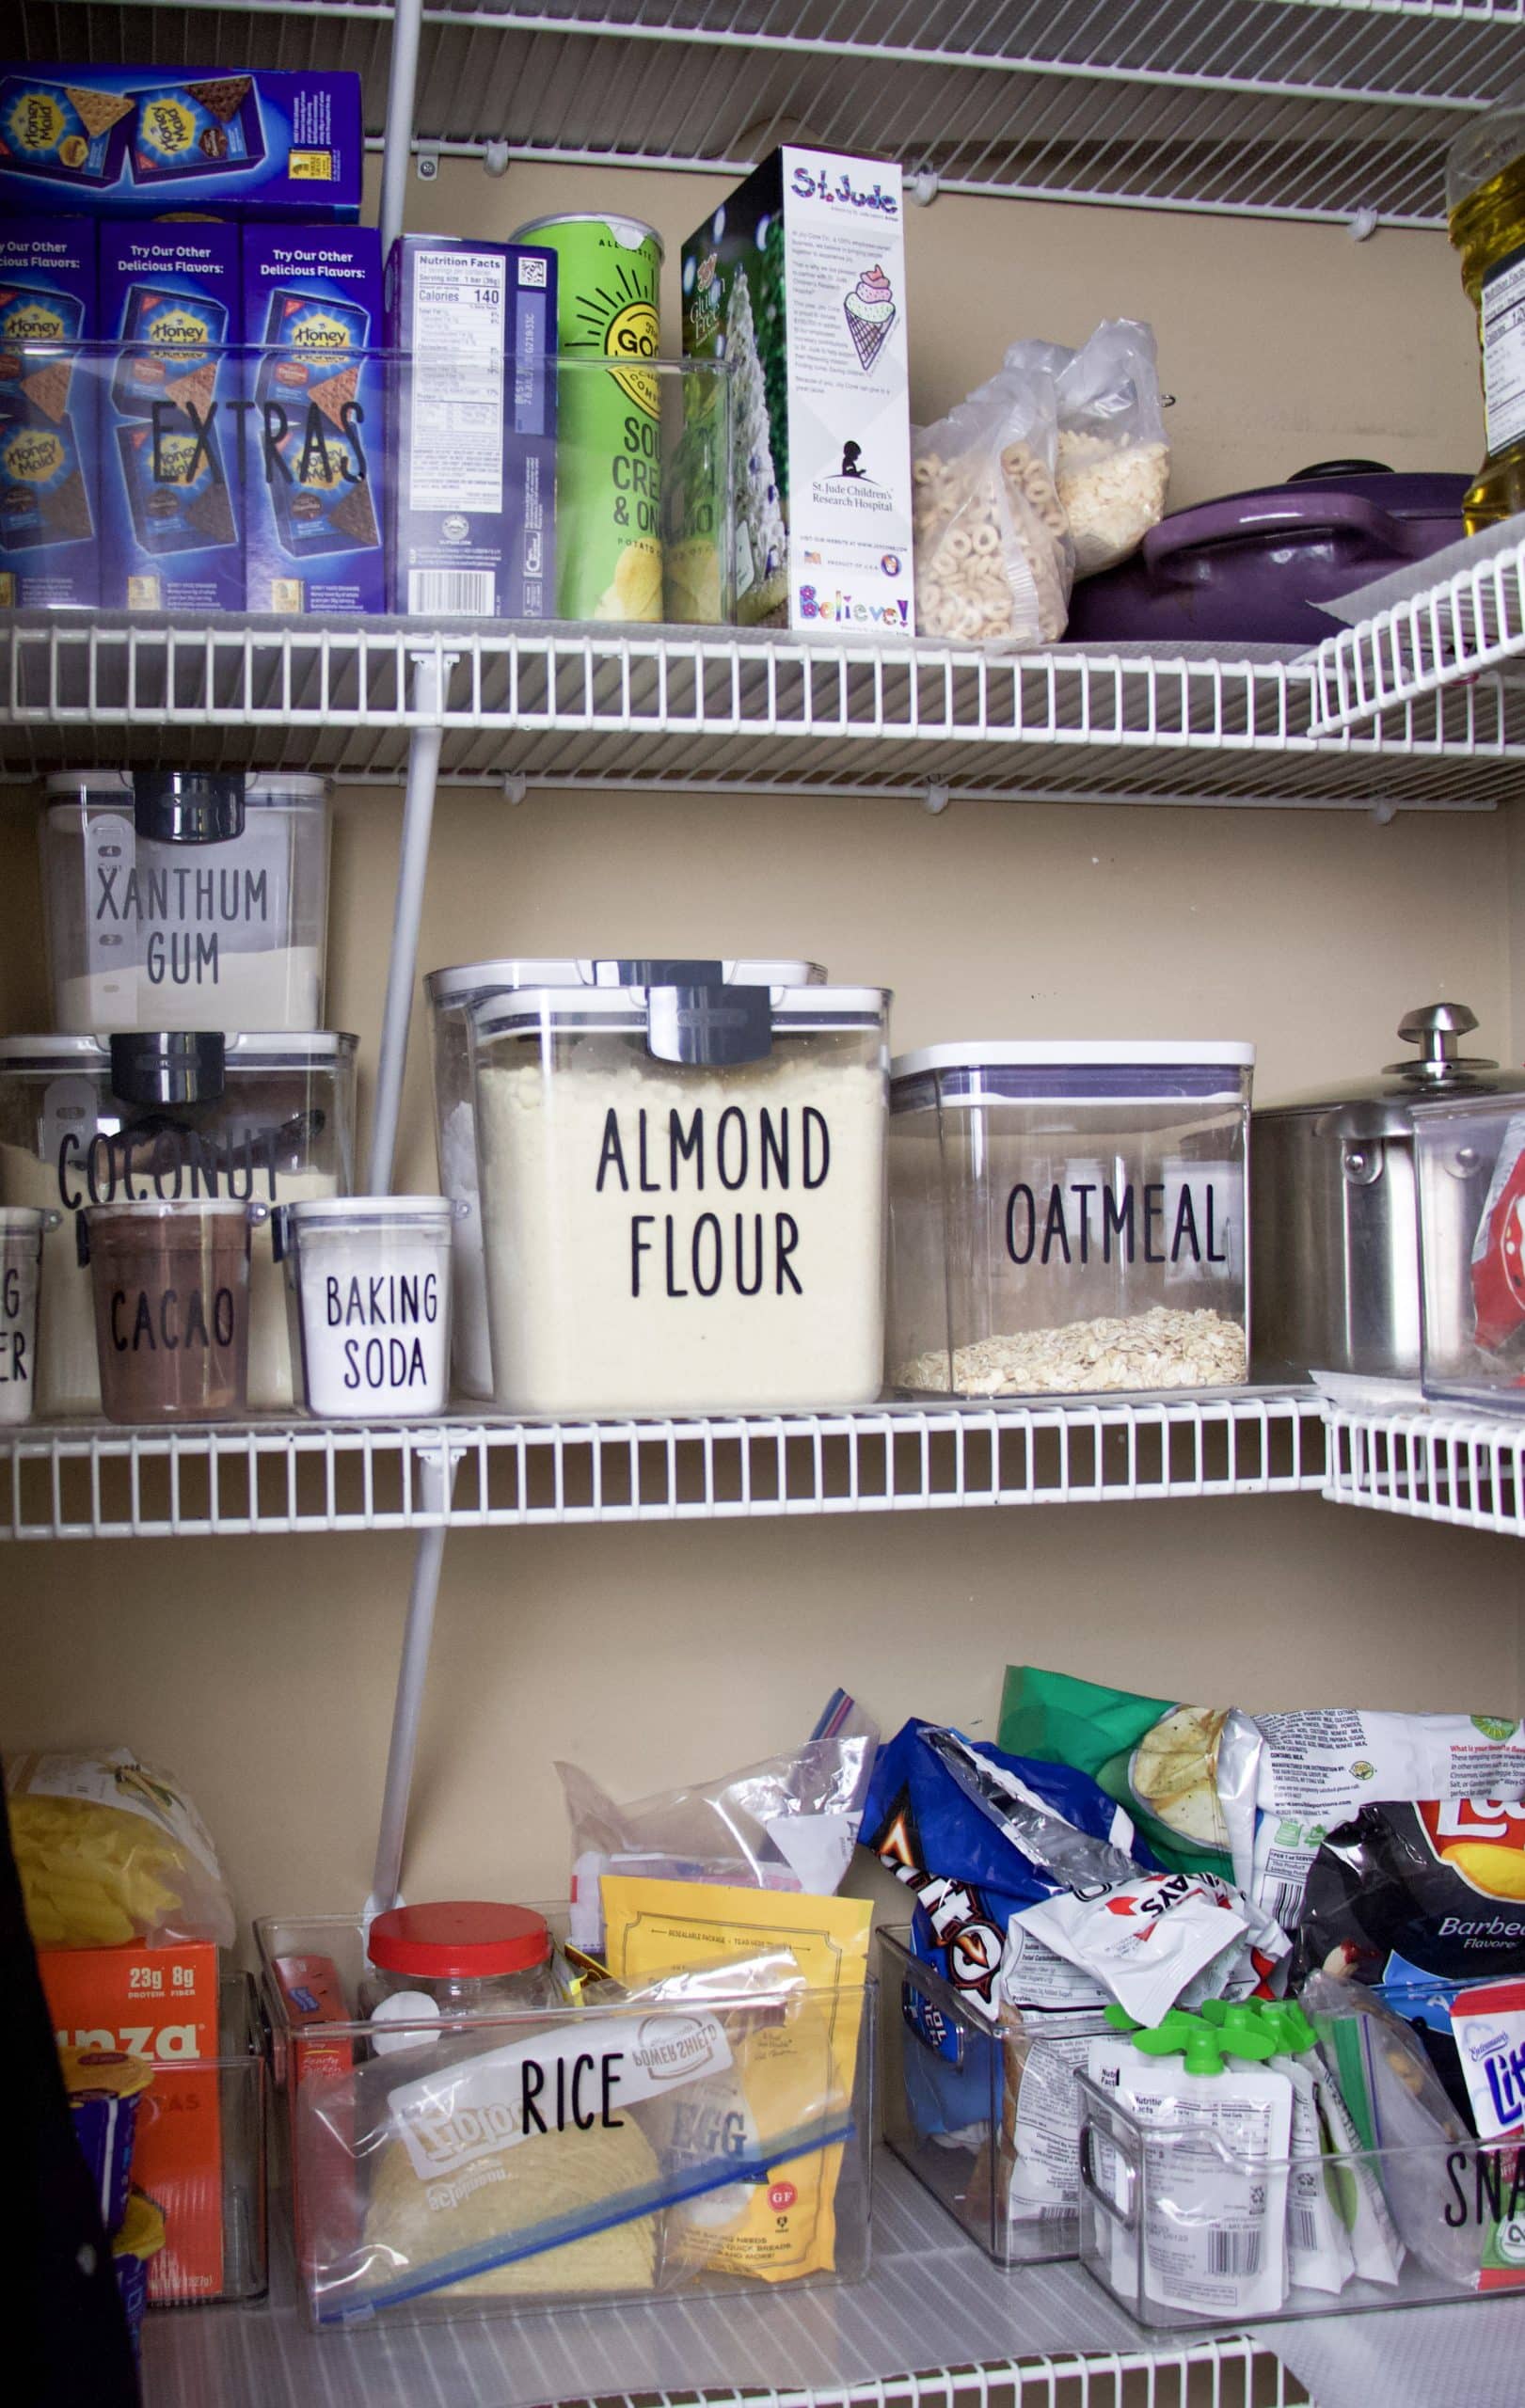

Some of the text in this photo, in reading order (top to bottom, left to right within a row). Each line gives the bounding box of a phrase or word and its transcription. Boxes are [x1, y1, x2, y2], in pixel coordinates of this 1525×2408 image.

[24, 98, 40, 149] Honey
[40, 104, 53, 140] Maid
[151, 105, 172, 152] Honey
[168, 108, 189, 143] Maid
[8, 241, 30, 252] Our
[32, 242, 68, 253] Other
[131, 246, 212, 260] Try Our Other
[273, 248, 354, 263] Try Our Other
[0, 256, 81, 269] cious Flavors:
[118, 260, 224, 274] Delicious Flavors:
[261, 263, 366, 278] Delicious Flavors:
[420, 255, 500, 269] Nutrition Facts
[420, 288, 500, 304] Calories 140
[7, 319, 60, 336] Honey
[153, 324, 204, 340] Honey
[294, 327, 346, 342] Honey
[151, 401, 367, 484] EXTRAS
[813, 482, 893, 500] St. Jude Children's
[813, 493, 894, 513] Research Hospital
[613, 496, 629, 527] &
[799, 584, 910, 629] Believe!
[96, 867, 268, 923] XANTHUM
[146, 930, 220, 985] GUM
[595, 1106, 831, 1193] ALMOND
[1006, 1182, 1227, 1265] OATMEAL
[631, 1212, 803, 1298] FLOUR
[326, 1273, 438, 1328] BAKING
[110, 1287, 235, 1352] CACAO
[342, 1337, 427, 1390] SODA
[130, 1965, 195, 1990] 23g 8g
[128, 1988, 196, 2000] PROTEIN FIBER
[521, 2052, 626, 2134] RICE
[771, 2190, 793, 2205] GF
